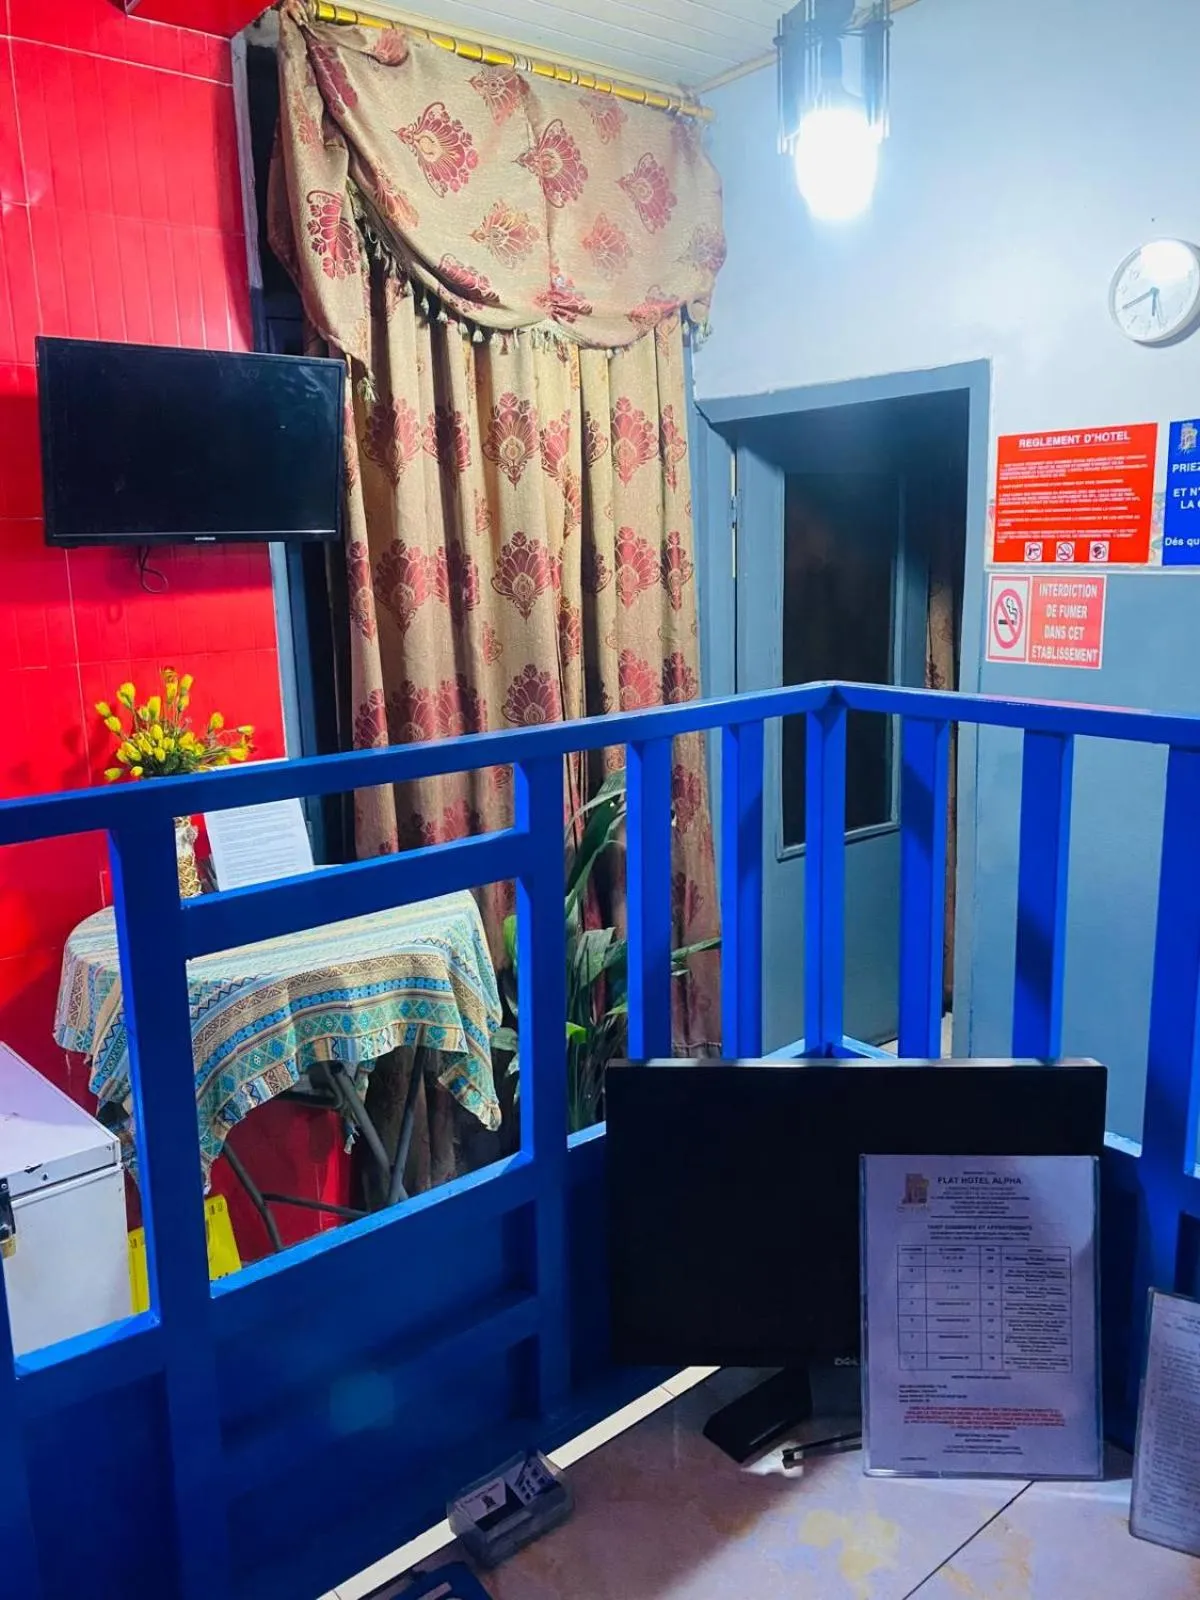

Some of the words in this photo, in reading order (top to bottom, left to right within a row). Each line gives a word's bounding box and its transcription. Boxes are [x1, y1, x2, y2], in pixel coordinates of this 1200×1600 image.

[1018, 434, 1081, 449] REGLEMENT
[1083, 430, 1131, 444] D'HOTEL
[1173, 487, 1187, 497] ET
[1180, 500, 1195, 509] LA
[1039, 583, 1098, 598] INTERDICTION
[1046, 603, 1057, 618] DE
[1059, 604, 1088, 619] FUMER
[1044, 624, 1066, 639] DANS
[1068, 626, 1085, 640] CET
[961, 1176, 989, 1185] HOTEL
[991, 1176, 1022, 1185] ALPHA
